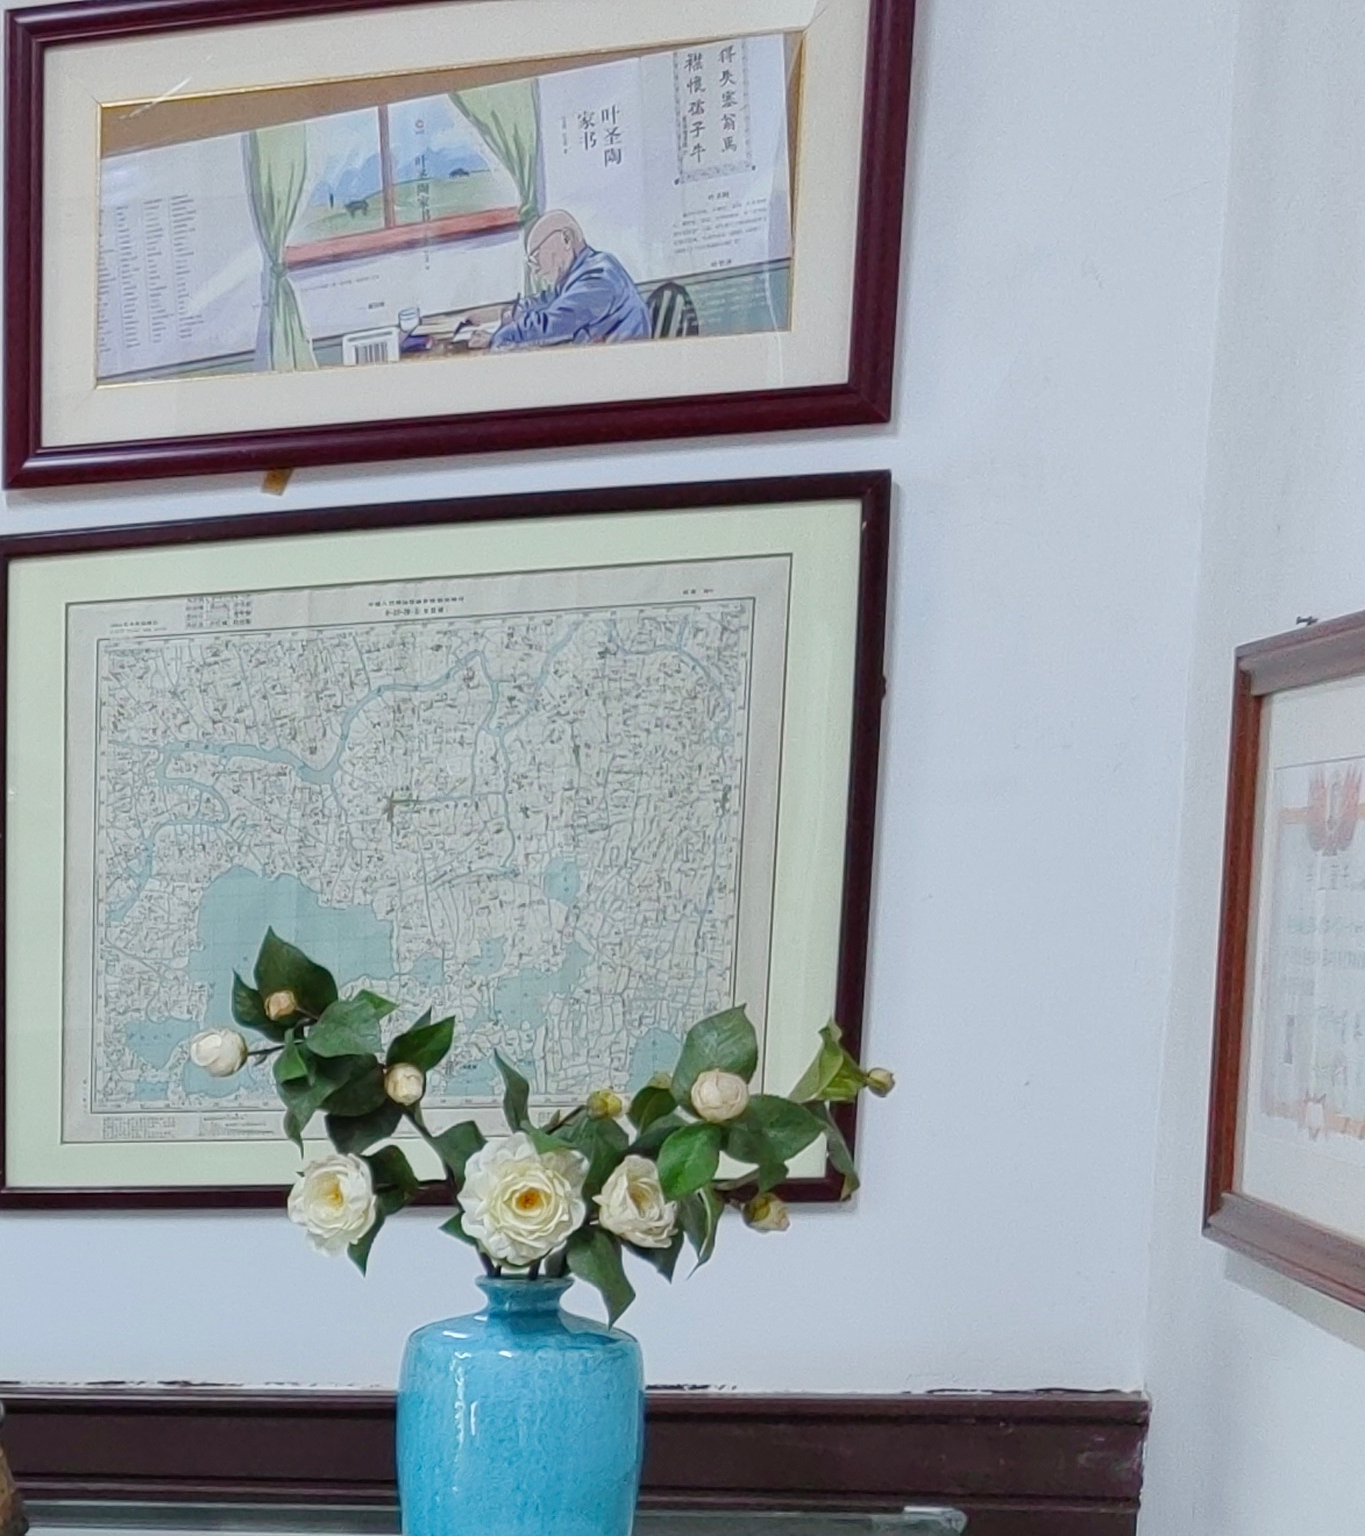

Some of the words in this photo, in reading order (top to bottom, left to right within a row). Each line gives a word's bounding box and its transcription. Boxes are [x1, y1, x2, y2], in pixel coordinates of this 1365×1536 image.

[577, 110, 597, 151] 家书
[601, 104, 622, 168] 叶圣陶
